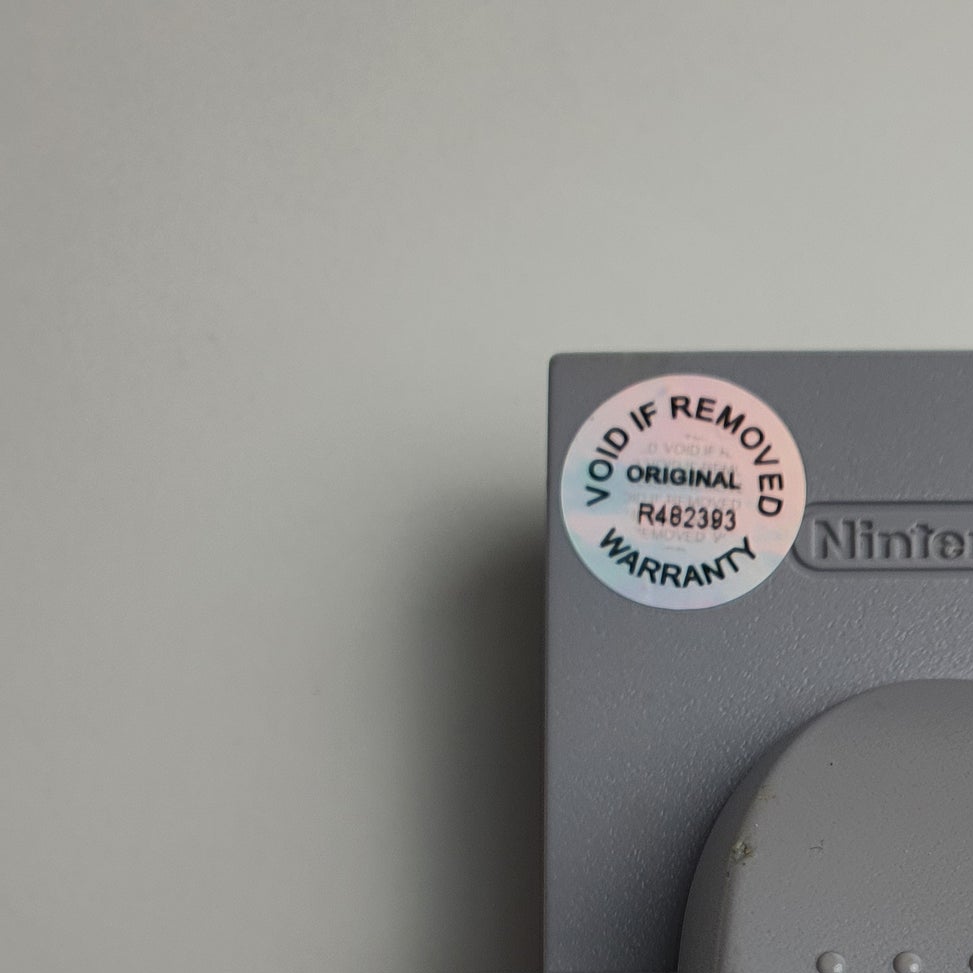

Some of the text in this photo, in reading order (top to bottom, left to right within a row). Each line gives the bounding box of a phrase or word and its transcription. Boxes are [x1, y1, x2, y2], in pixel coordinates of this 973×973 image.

[585, 395, 784, 518] VOID IF REMOVED
[626, 465, 741, 490] ORIGINAL
[599, 527, 756, 588] WARRANTY
